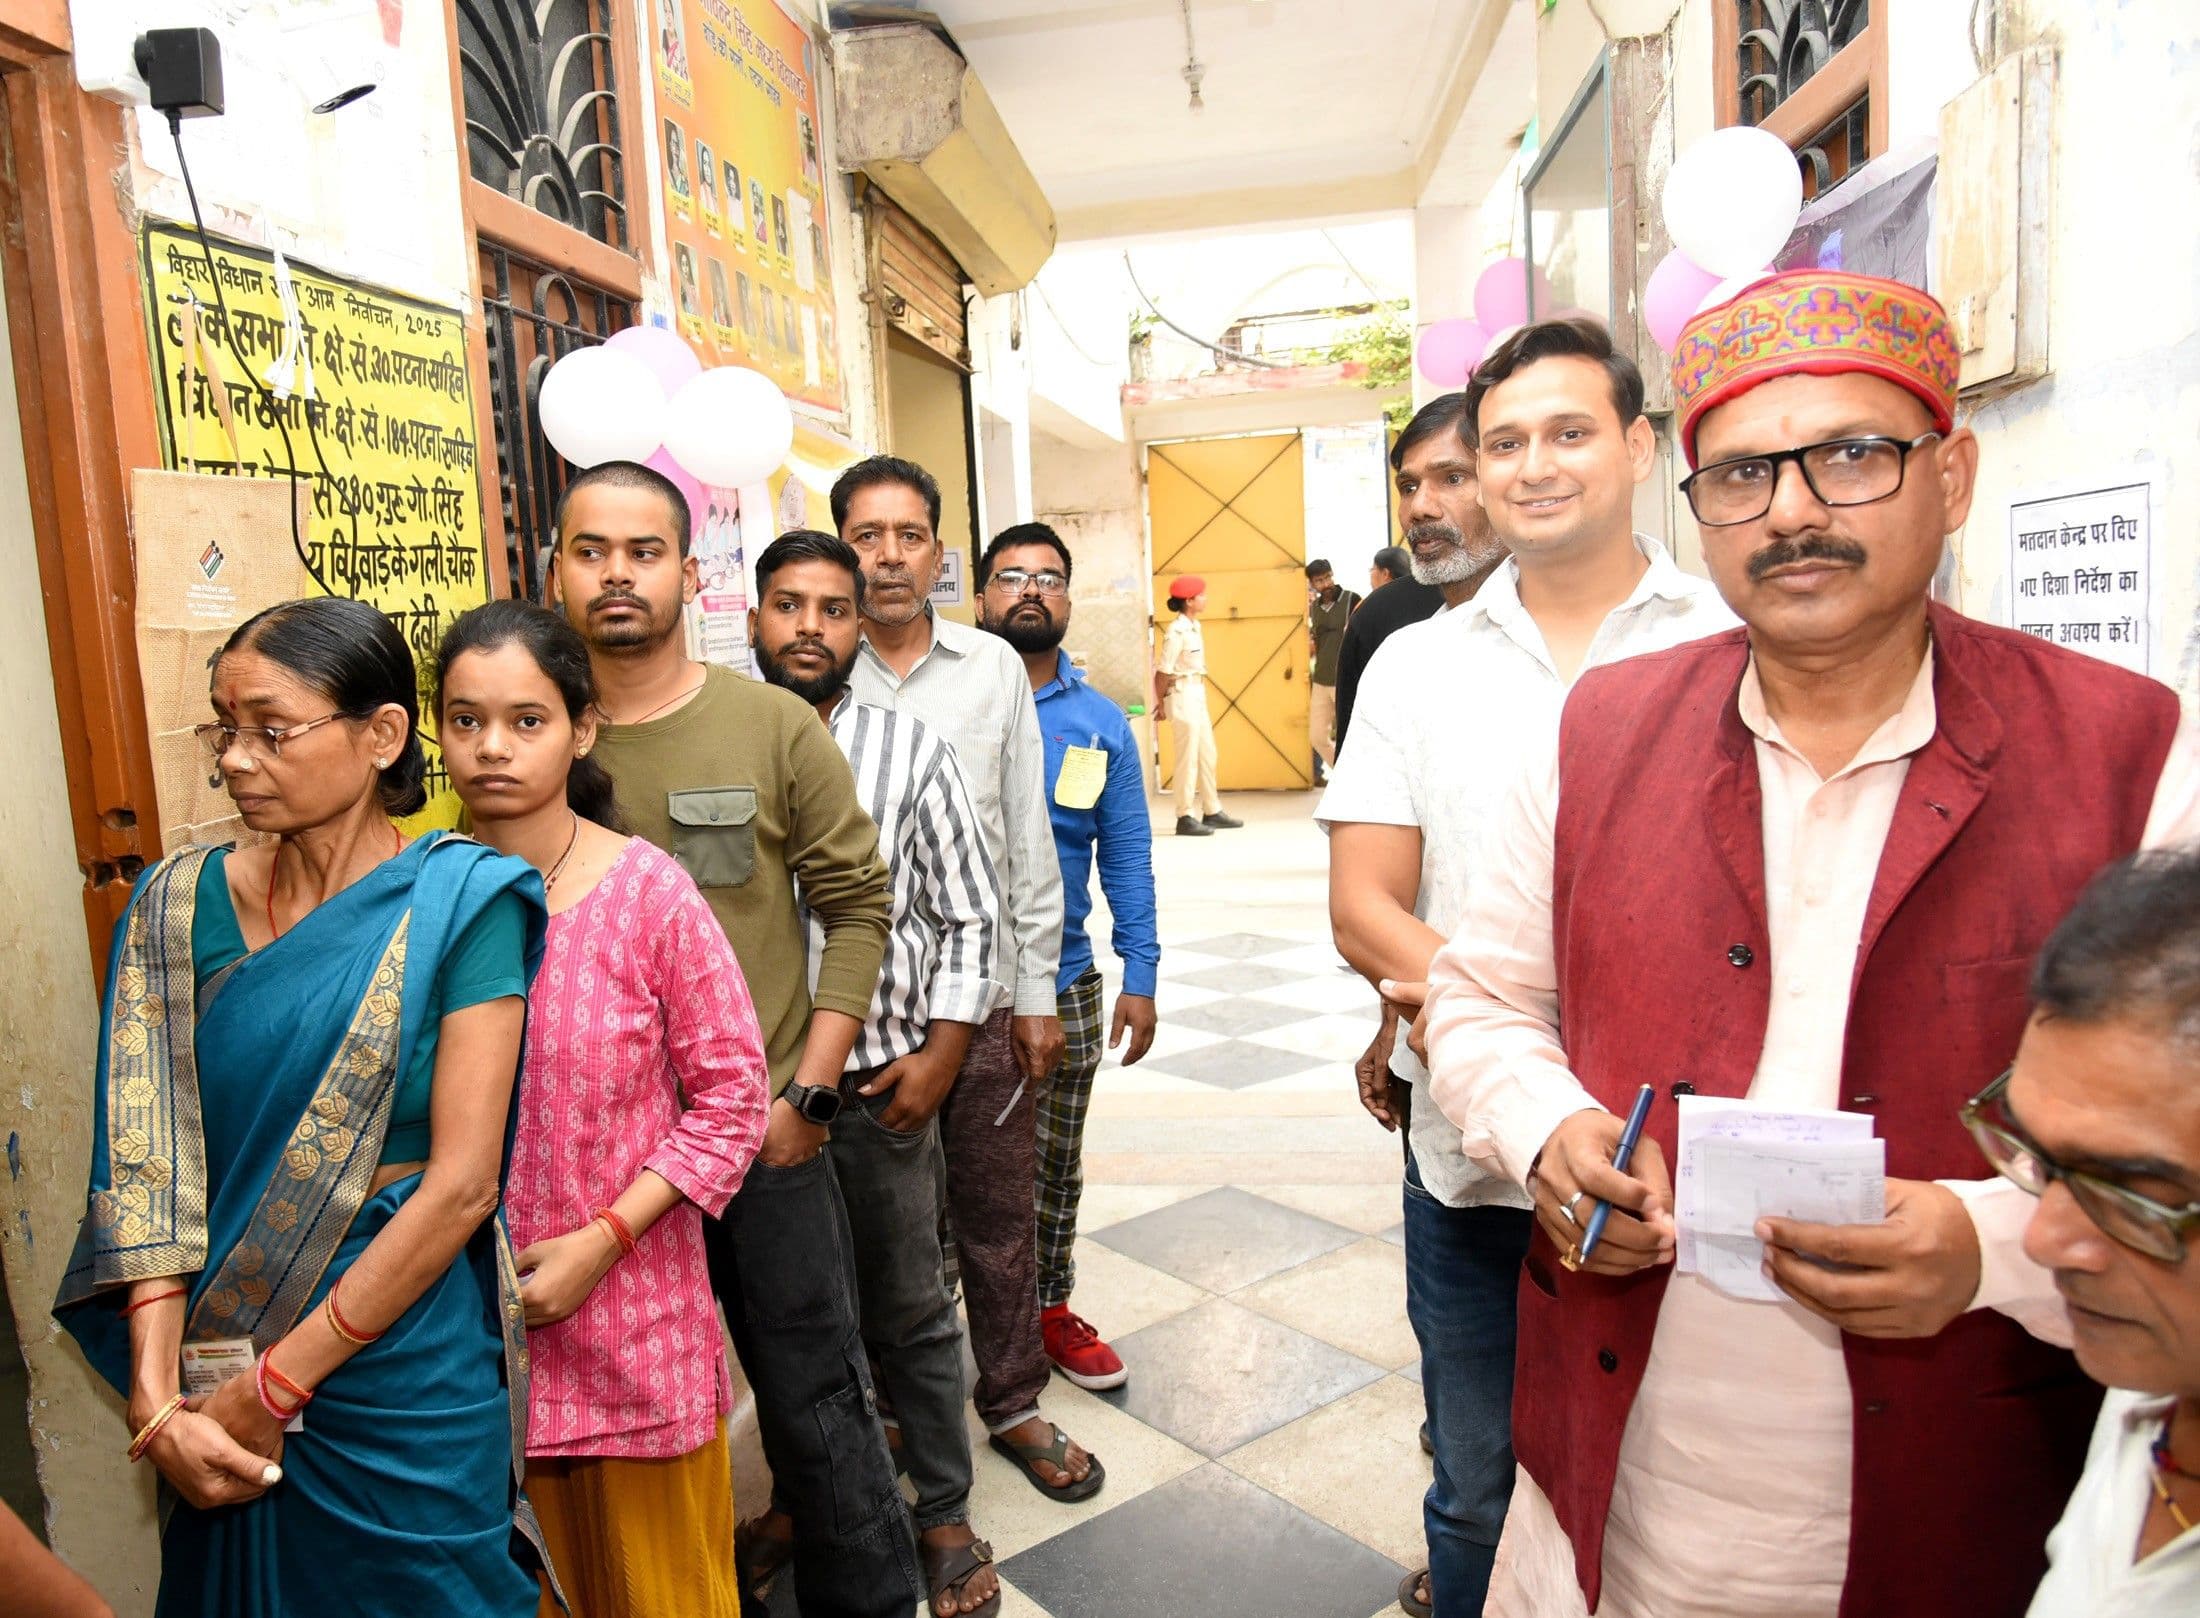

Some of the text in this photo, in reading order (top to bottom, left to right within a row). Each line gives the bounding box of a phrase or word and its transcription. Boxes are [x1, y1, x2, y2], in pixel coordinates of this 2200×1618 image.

[306, 285, 336, 311] आम
[405, 313, 442, 338] 2025
[432, 476, 464, 532] सिंह
[2018, 515, 2138, 552] मतदान केन्द्र पर दिए
[2042, 571, 2069, 596] दिशा
[2074, 566, 2112, 594] निर्देश
[2118, 571, 2138, 592] का
[2059, 623, 2101, 642] अवश्य
